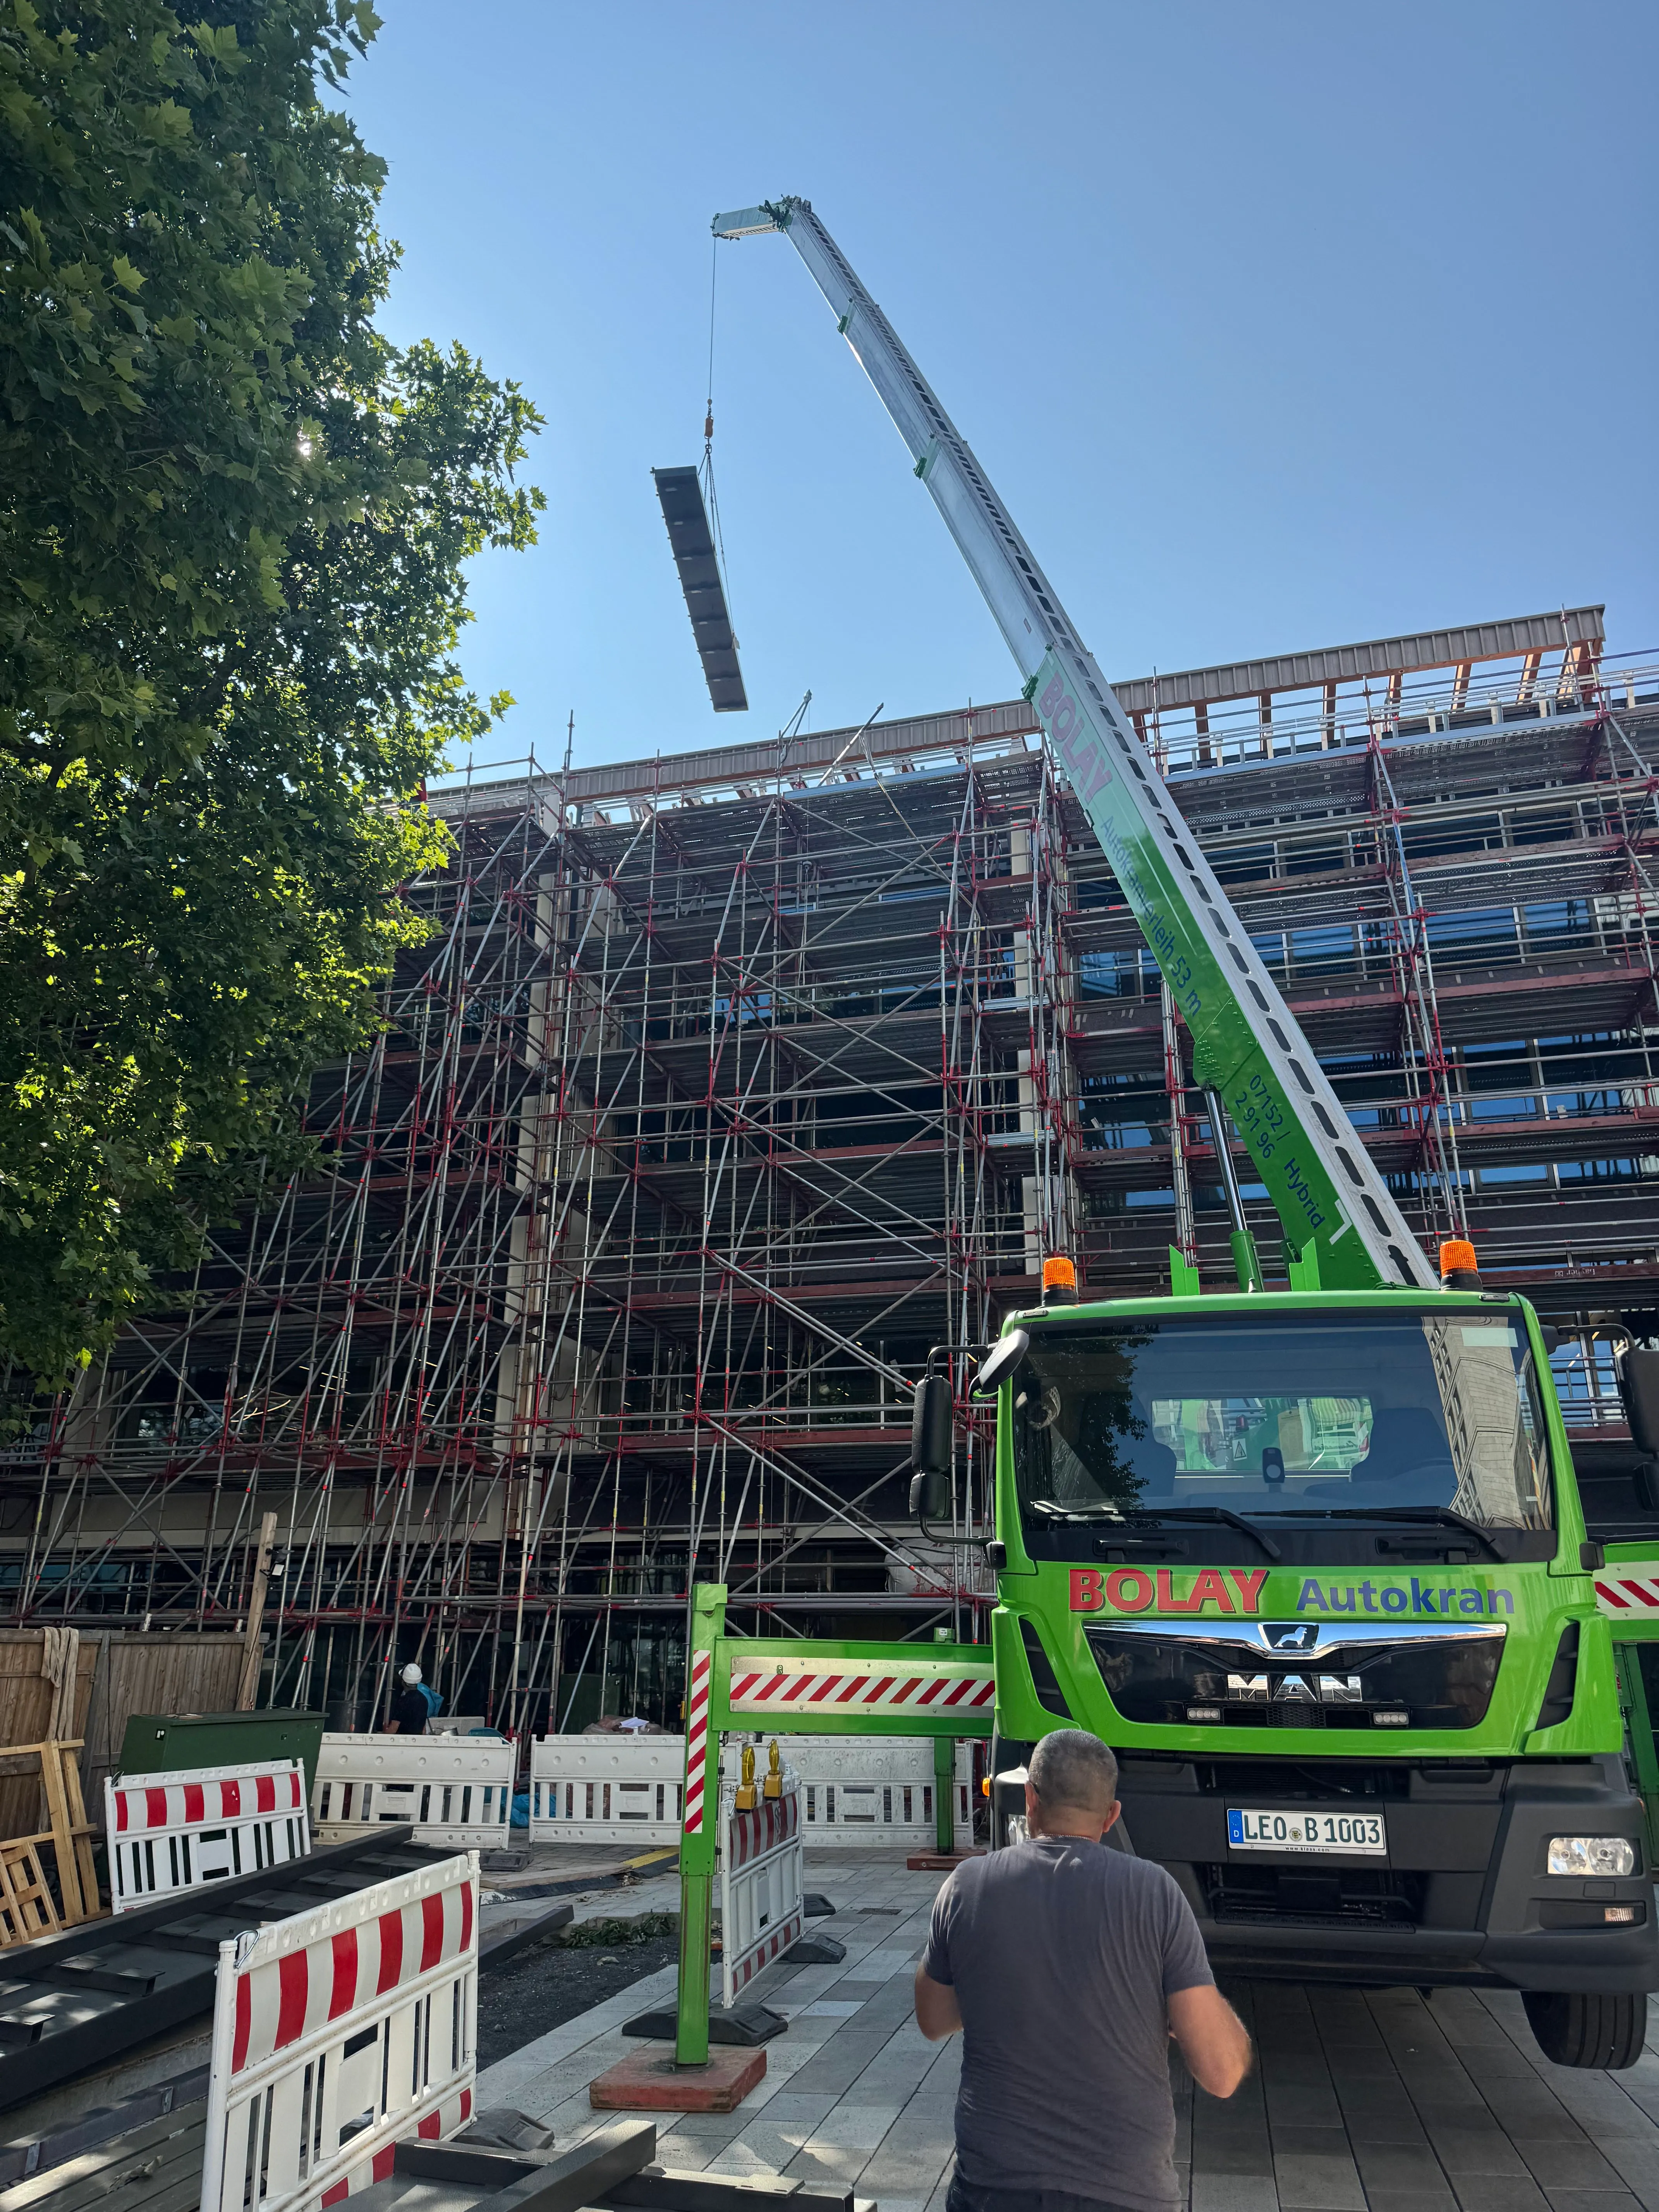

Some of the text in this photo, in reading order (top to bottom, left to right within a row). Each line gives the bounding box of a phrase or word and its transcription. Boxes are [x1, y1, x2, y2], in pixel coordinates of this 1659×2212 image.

[1039, 670, 1113, 805] BOLAY
[1101, 815, 1202, 1017] Autokranverleih 53 m
[1250, 1075, 1283, 1132] 07152
[1284, 1157, 1326, 1230] Hybrid
[1069, 1568, 1515, 1614] BOLAY Autokran
[1227, 1674, 1362, 1702] MAN
[1244, 1815, 1380, 1844] LEO B 1003
